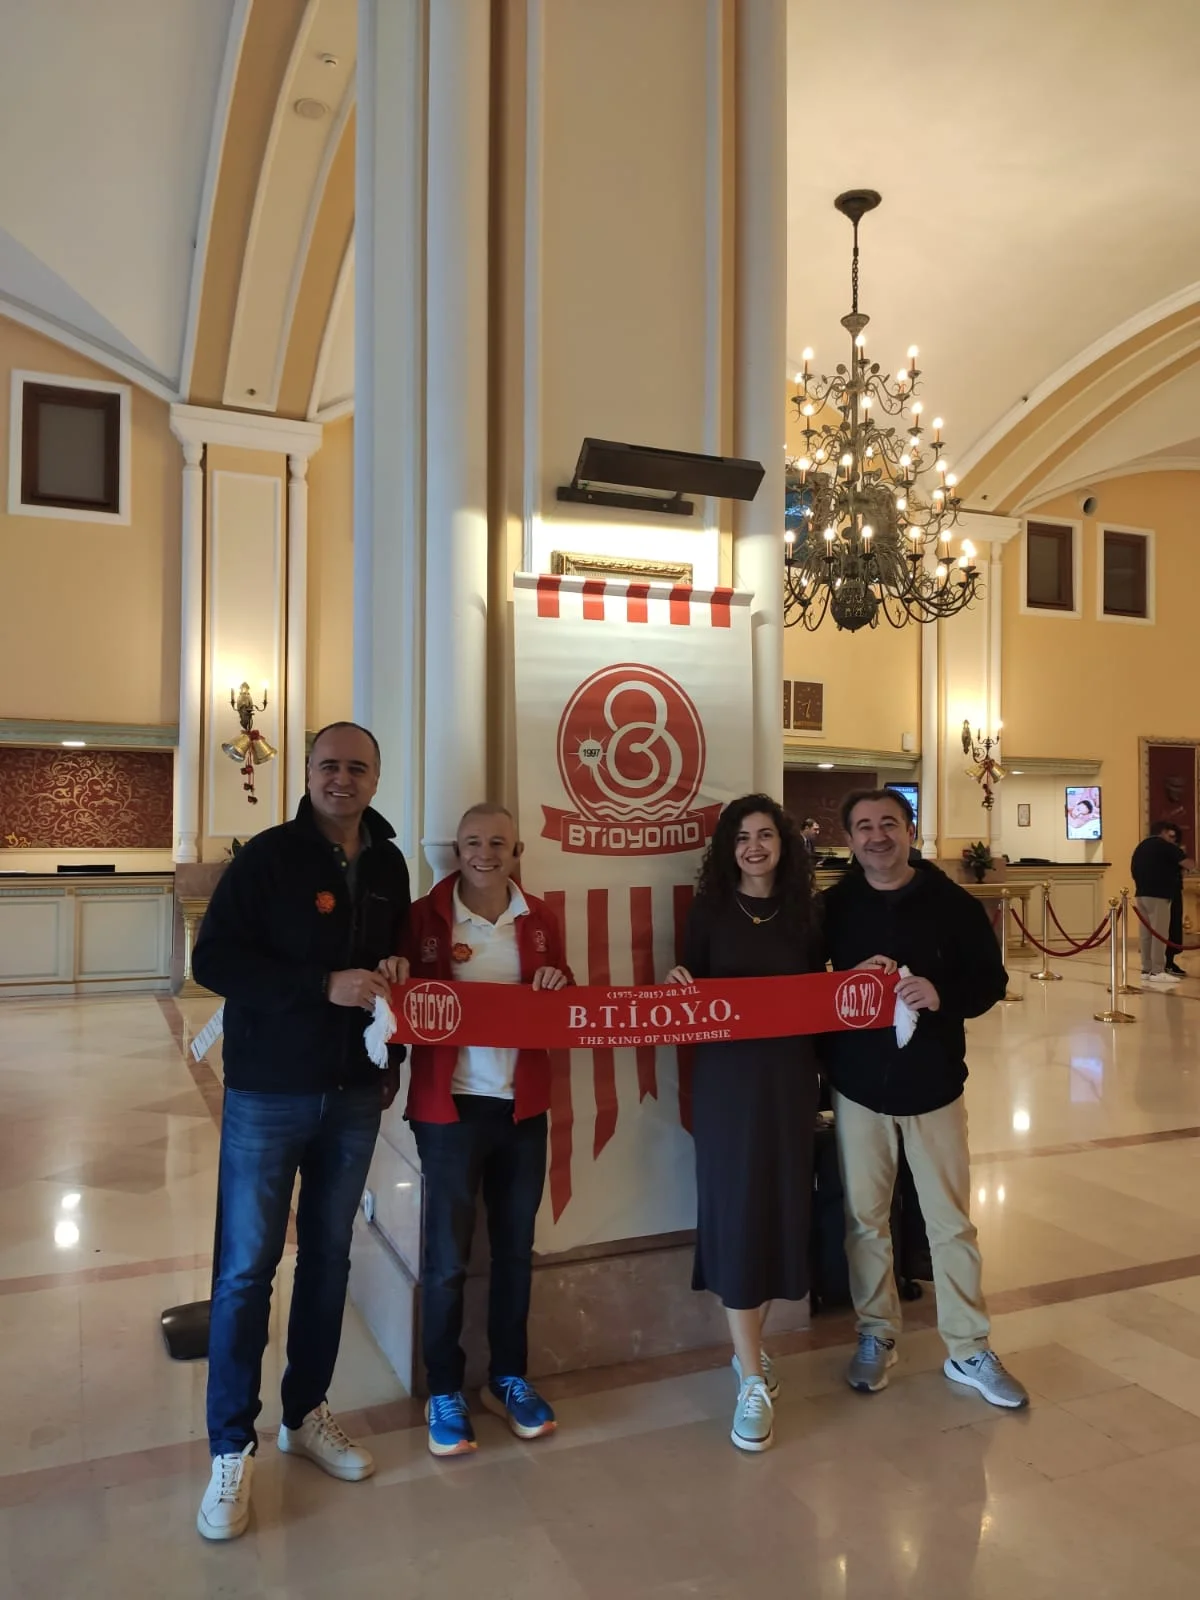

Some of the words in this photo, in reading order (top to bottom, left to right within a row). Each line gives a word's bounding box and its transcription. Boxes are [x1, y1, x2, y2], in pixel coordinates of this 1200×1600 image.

[583, 748, 601, 758] 1997
[606, 990, 664, 999] (1975-2015)
[579, 1035, 604, 1045] THE
[607, 1035, 641, 1045] KING
[644, 1034, 661, 1043] OF
[663, 1029, 731, 1043] UNIVERSIE
